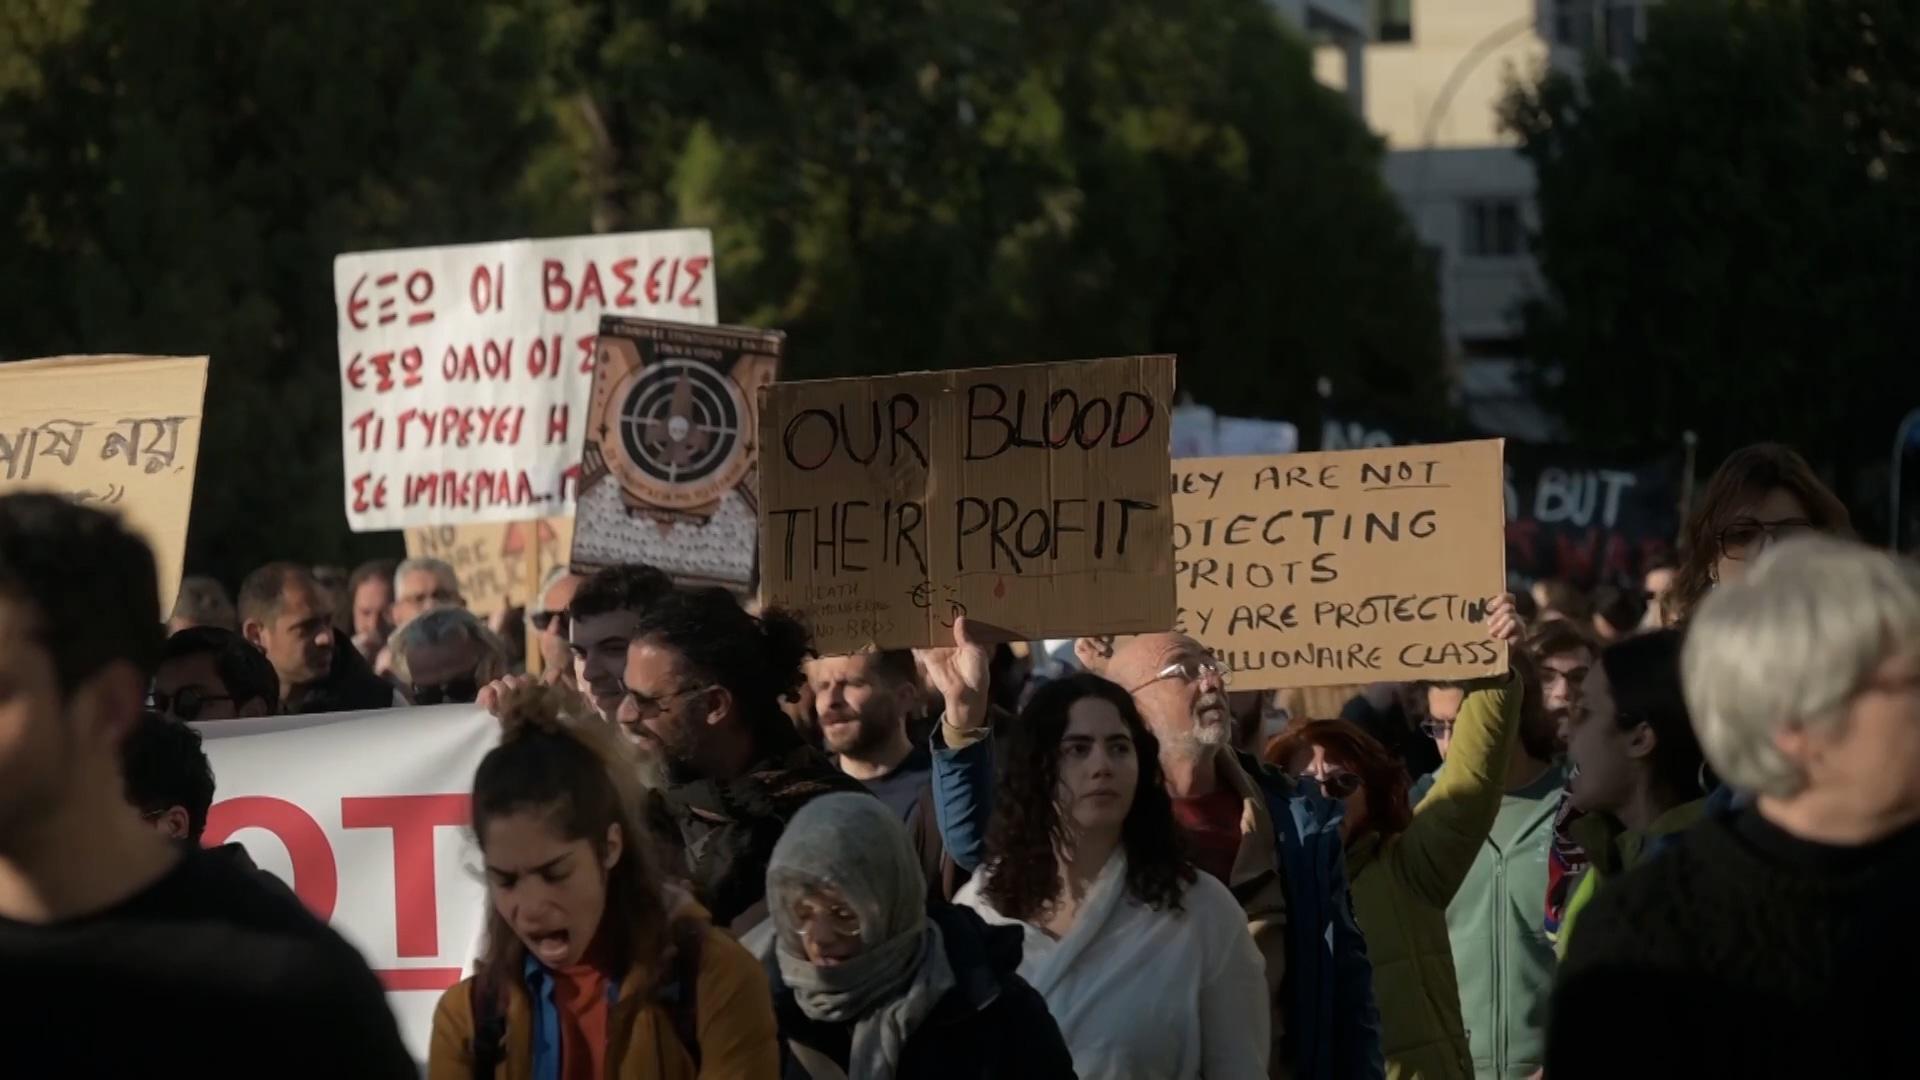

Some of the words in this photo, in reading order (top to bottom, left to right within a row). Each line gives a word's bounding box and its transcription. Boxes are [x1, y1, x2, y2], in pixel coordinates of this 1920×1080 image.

[470, 262, 505, 314] ΟΙ
[543, 256, 710, 313] ΒΑΣΕΙΣ
[442, 338, 514, 383] ΟΛΟΙ
[527, 334, 563, 380] ΟΙ
[783, 393, 928, 470] OUR
[965, 384, 1154, 461] BLOOD
[1172, 471, 1224, 500] EY
[1254, 465, 1342, 491] ARE
[1361, 461, 1441, 486] NOT
[1534, 466, 1638, 529] BUT
[769, 501, 929, 582] THEIR
[956, 497, 1160, 574] PROFIT
[1173, 509, 1437, 550] OTECTING
[1176, 552, 1339, 590] PRIOTS
[1175, 606, 1214, 635] EY
[1228, 603, 1300, 636] ARE
[1399, 639, 1498, 668] CLASS
[200, 793, 473, 959] OT
